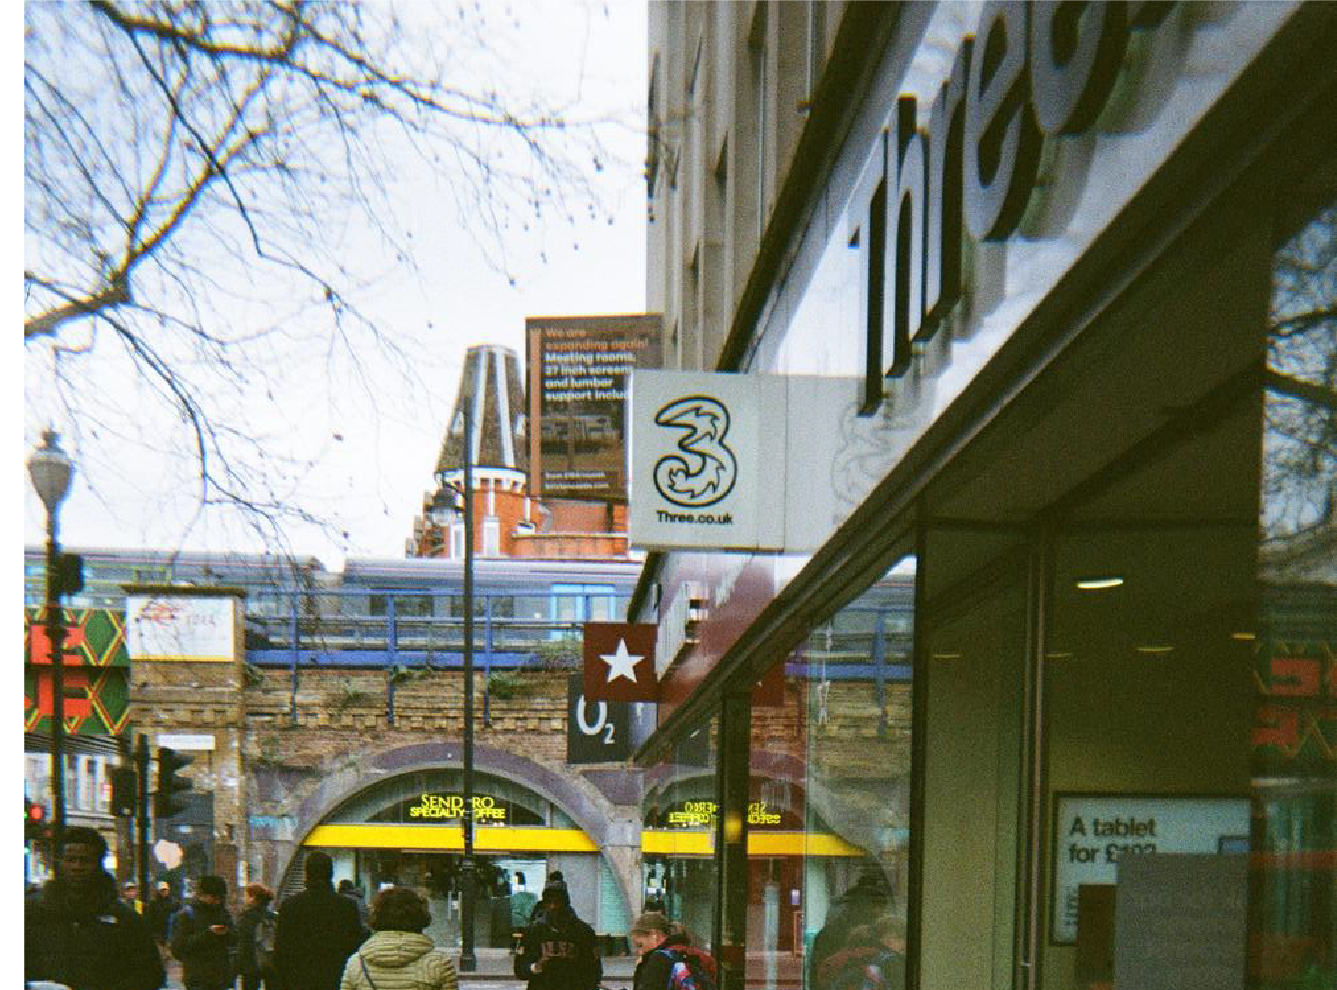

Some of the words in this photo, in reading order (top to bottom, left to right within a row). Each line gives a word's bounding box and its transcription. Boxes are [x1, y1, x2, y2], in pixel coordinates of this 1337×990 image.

[545, 338, 608, 351] expanding
[545, 352, 594, 365] Meeting
[561, 365, 590, 375] inch
[545, 378, 568, 388] and
[571, 377, 613, 388] lumbar
[545, 390, 592, 402] support
[656, 509, 734, 525] Three.co.uk
[421, 793, 495, 809] SENDRO
[473, 808, 506, 819] OFFEE
[1069, 815, 1087, 837] A
[1092, 816, 1157, 837] tablet
[1068, 843, 1101, 864] for
